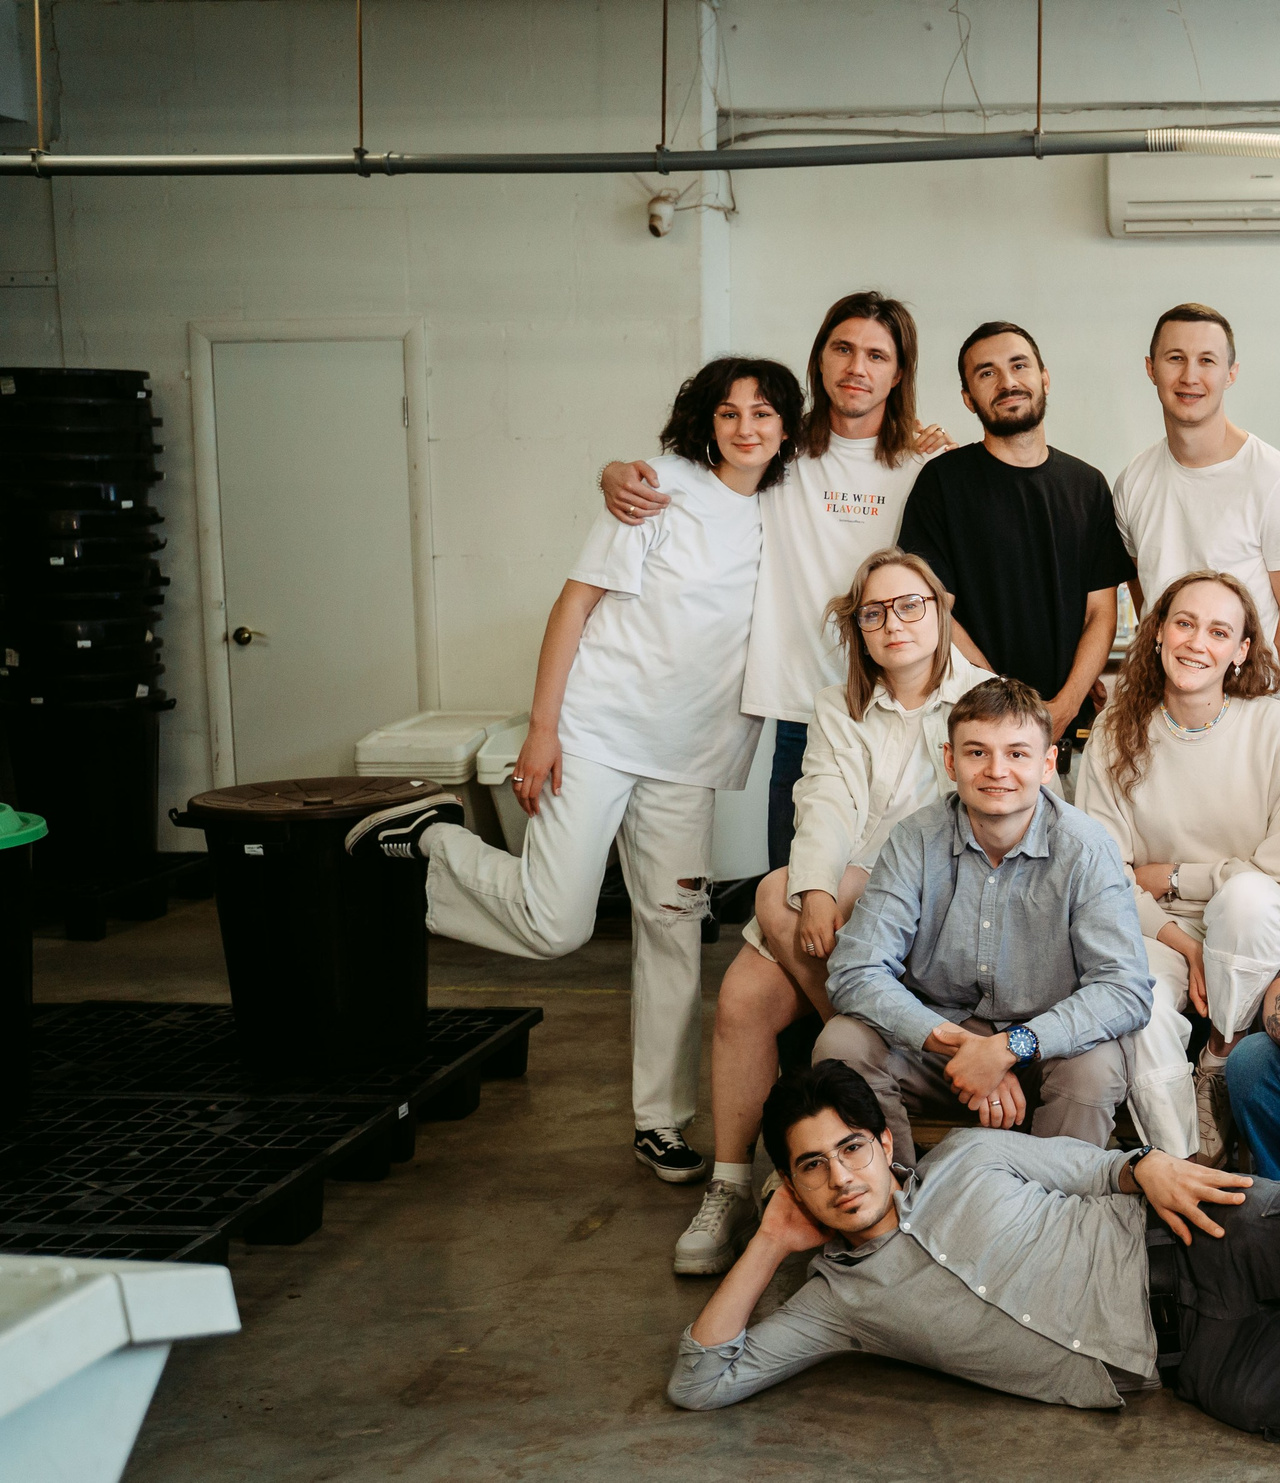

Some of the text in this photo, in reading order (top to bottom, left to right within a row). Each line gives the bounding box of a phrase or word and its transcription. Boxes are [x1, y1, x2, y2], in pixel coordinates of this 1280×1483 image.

[824, 491, 885, 504] LIFE WITH
[826, 503, 878, 516] FLAVOUR
